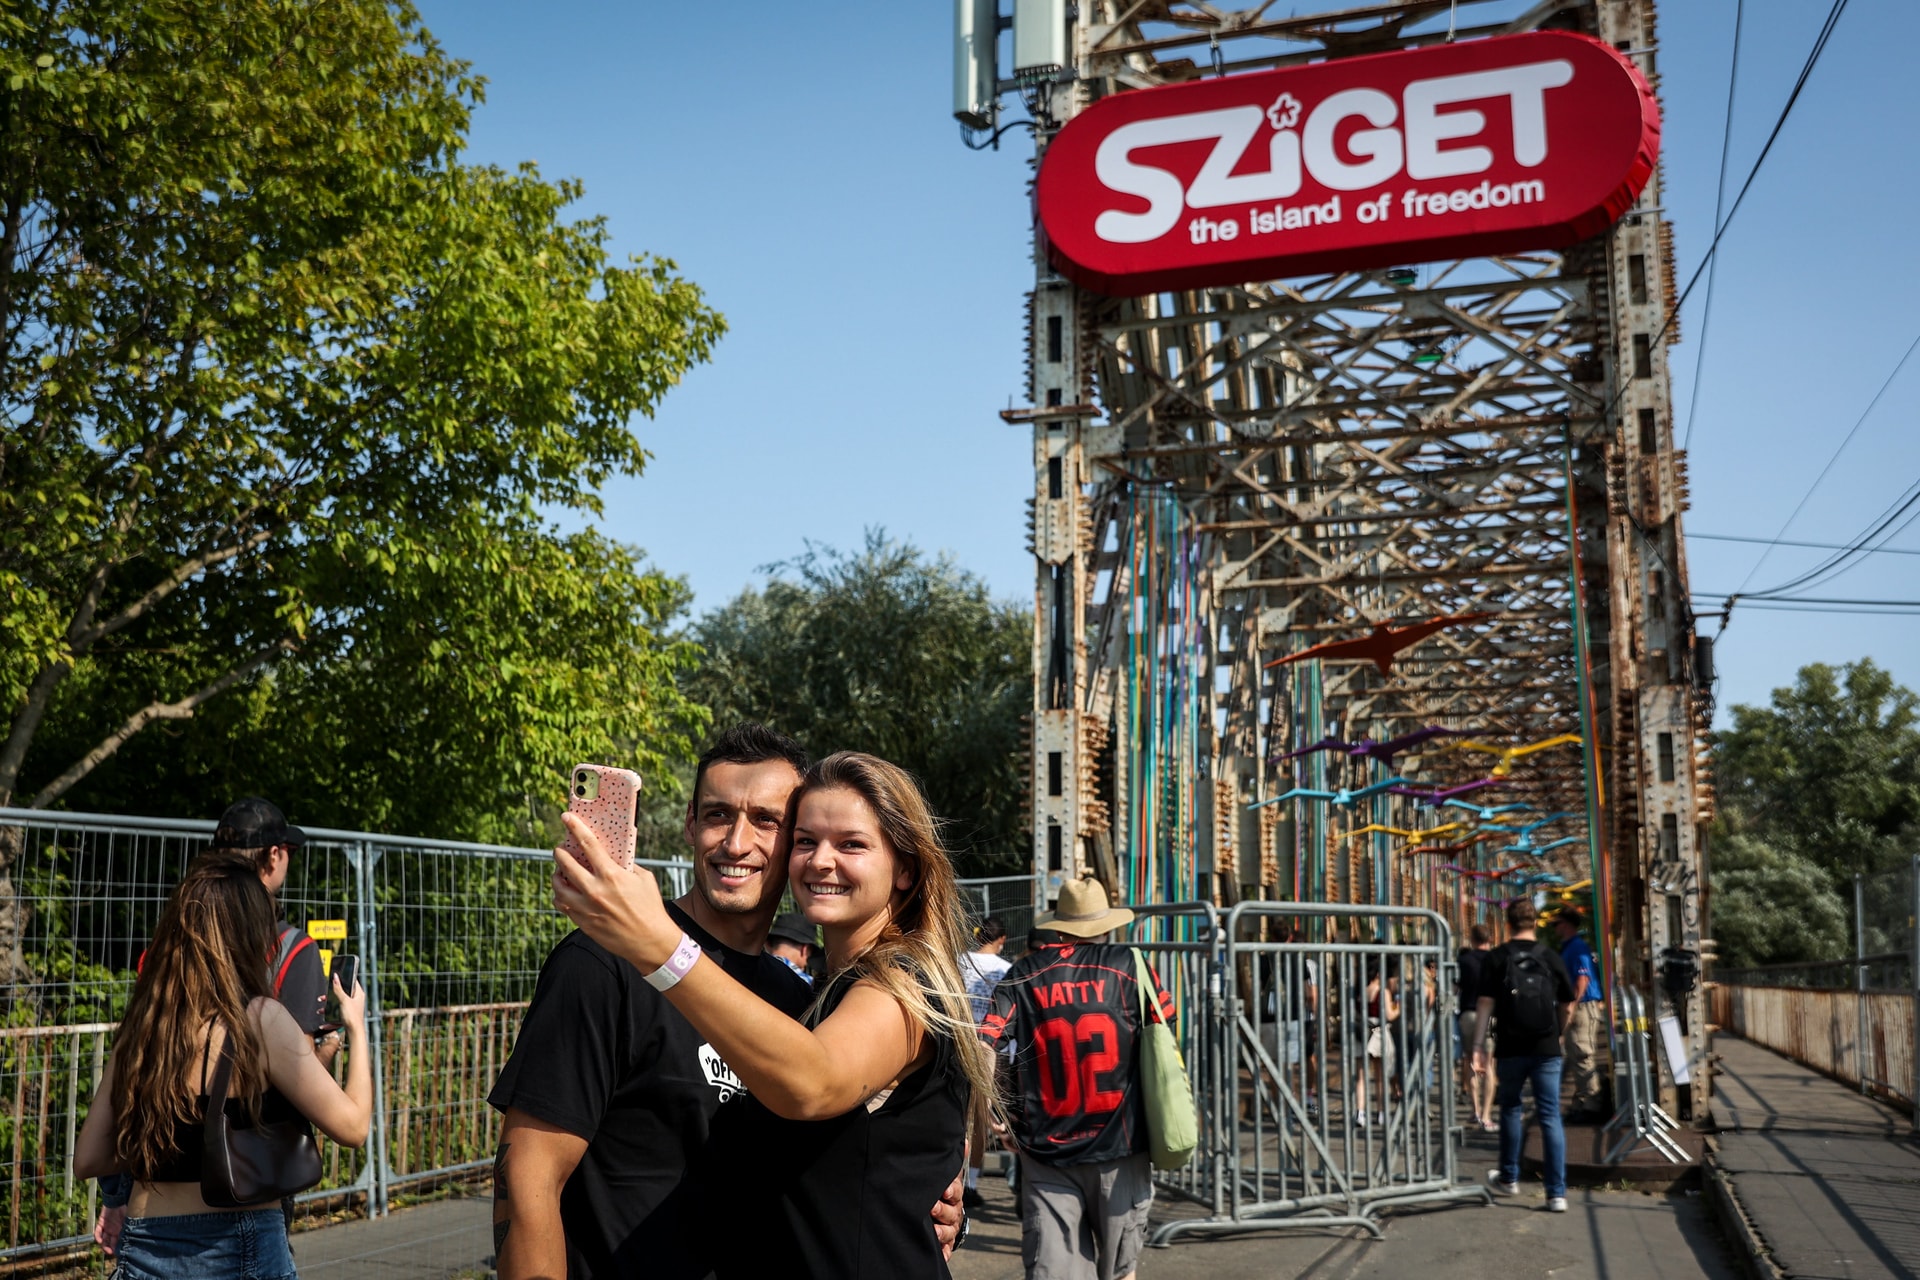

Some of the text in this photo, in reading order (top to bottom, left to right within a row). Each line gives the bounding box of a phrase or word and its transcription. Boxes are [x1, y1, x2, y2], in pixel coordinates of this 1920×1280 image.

[1188, 179, 1545, 245] the island of freedom
[1033, 979, 1106, 1009] NATTY
[1034, 1013, 1124, 1117] 02
